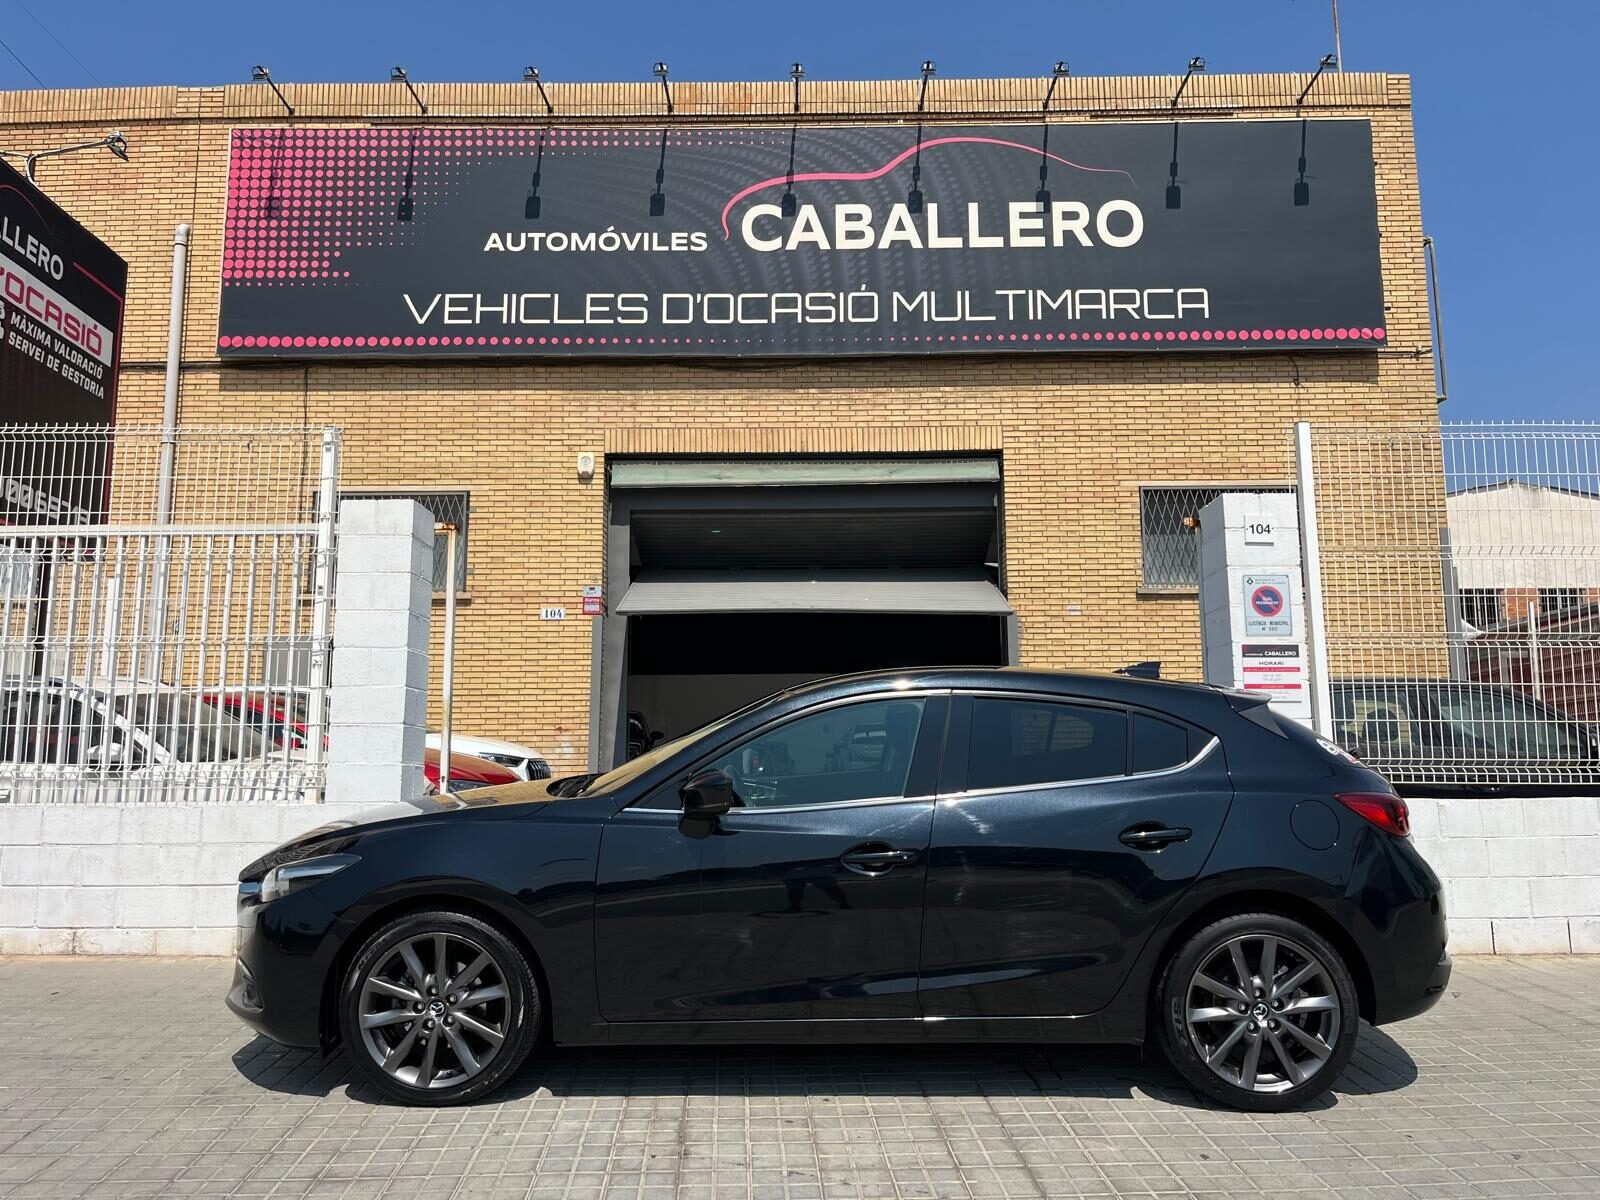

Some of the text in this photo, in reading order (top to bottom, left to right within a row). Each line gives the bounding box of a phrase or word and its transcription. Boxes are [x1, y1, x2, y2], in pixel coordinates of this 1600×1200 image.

[484, 200, 1144, 252] AUTOMÓVILES CABALLERO
[0, 216, 64, 280] LLERO
[404, 284, 1210, 325] VEHICLES D'OCASIÓ MULTIMARCA
[8, 331, 104, 399] SERVEI DE GESTORIA
[54, 338, 103, 380] VALORACIÓ
[1249, 523, 1271, 535] 104
[545, 609, 562, 619] 104
